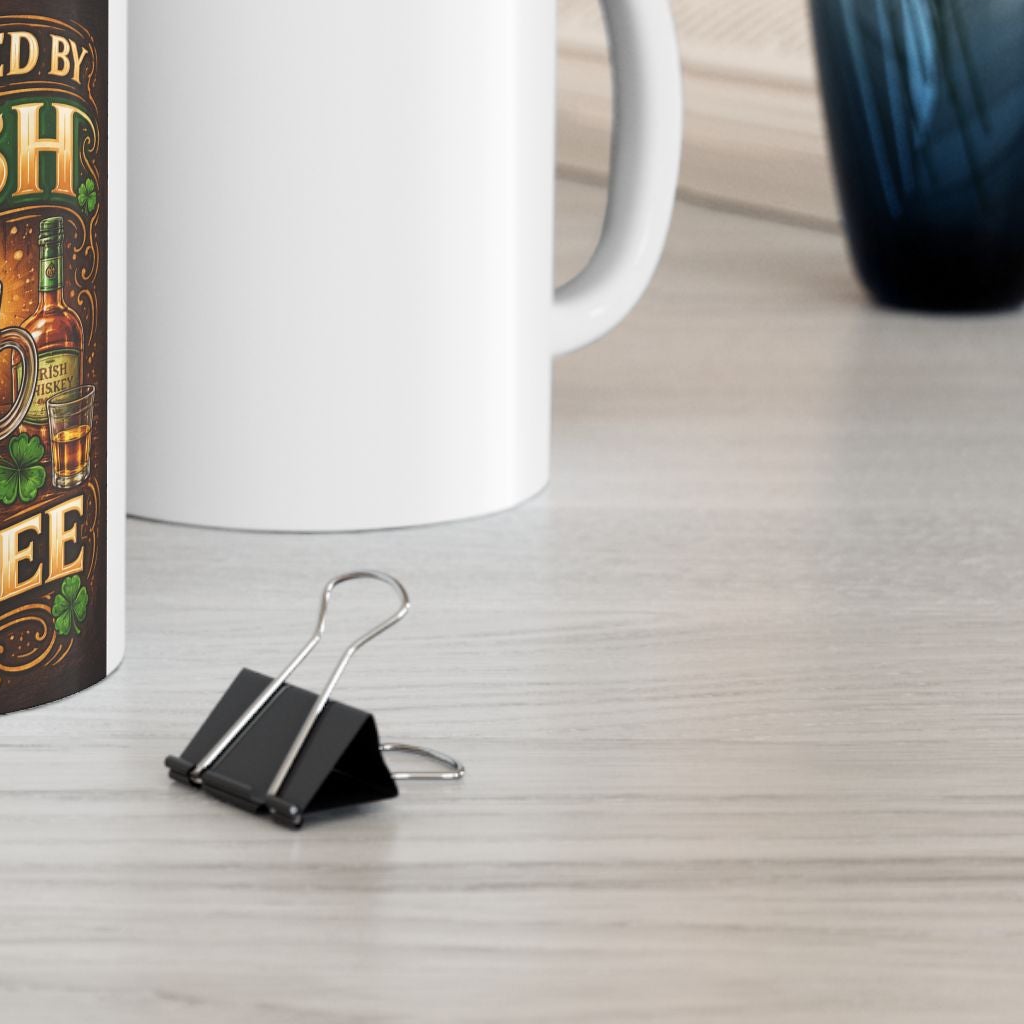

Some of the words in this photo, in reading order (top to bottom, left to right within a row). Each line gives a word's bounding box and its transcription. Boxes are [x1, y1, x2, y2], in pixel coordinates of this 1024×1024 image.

[49, 34, 88, 84] BY
[38, 362, 67, 381] RISH
[35, 376, 74, 396] HISKEY
